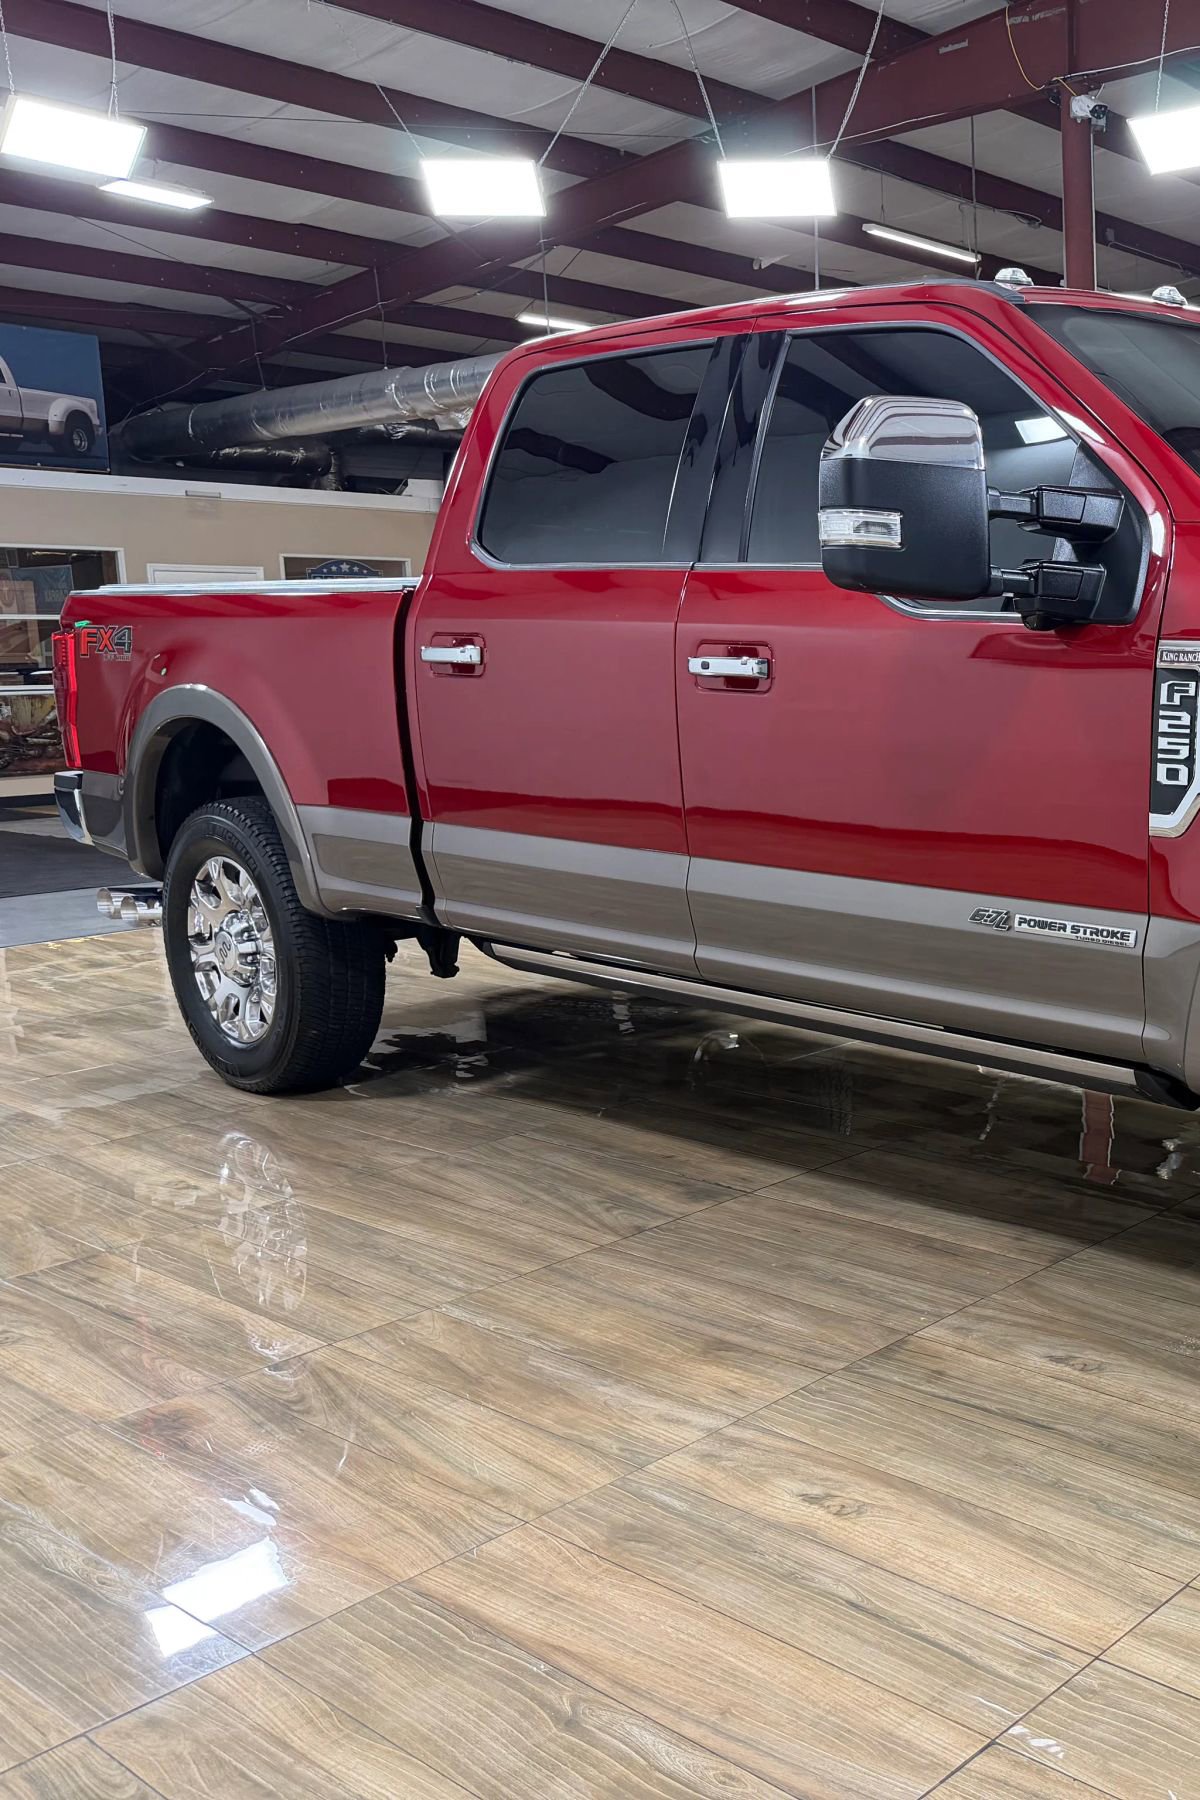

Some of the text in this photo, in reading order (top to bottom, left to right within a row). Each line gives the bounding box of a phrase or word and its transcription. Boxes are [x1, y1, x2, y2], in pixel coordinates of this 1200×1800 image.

[80, 625, 133, 658] FX4
[1162, 651, 1200, 662] KING RANCH
[1156, 680, 1197, 786] F250
[968, 906, 1131, 942] 6.7L POWER STROKE
